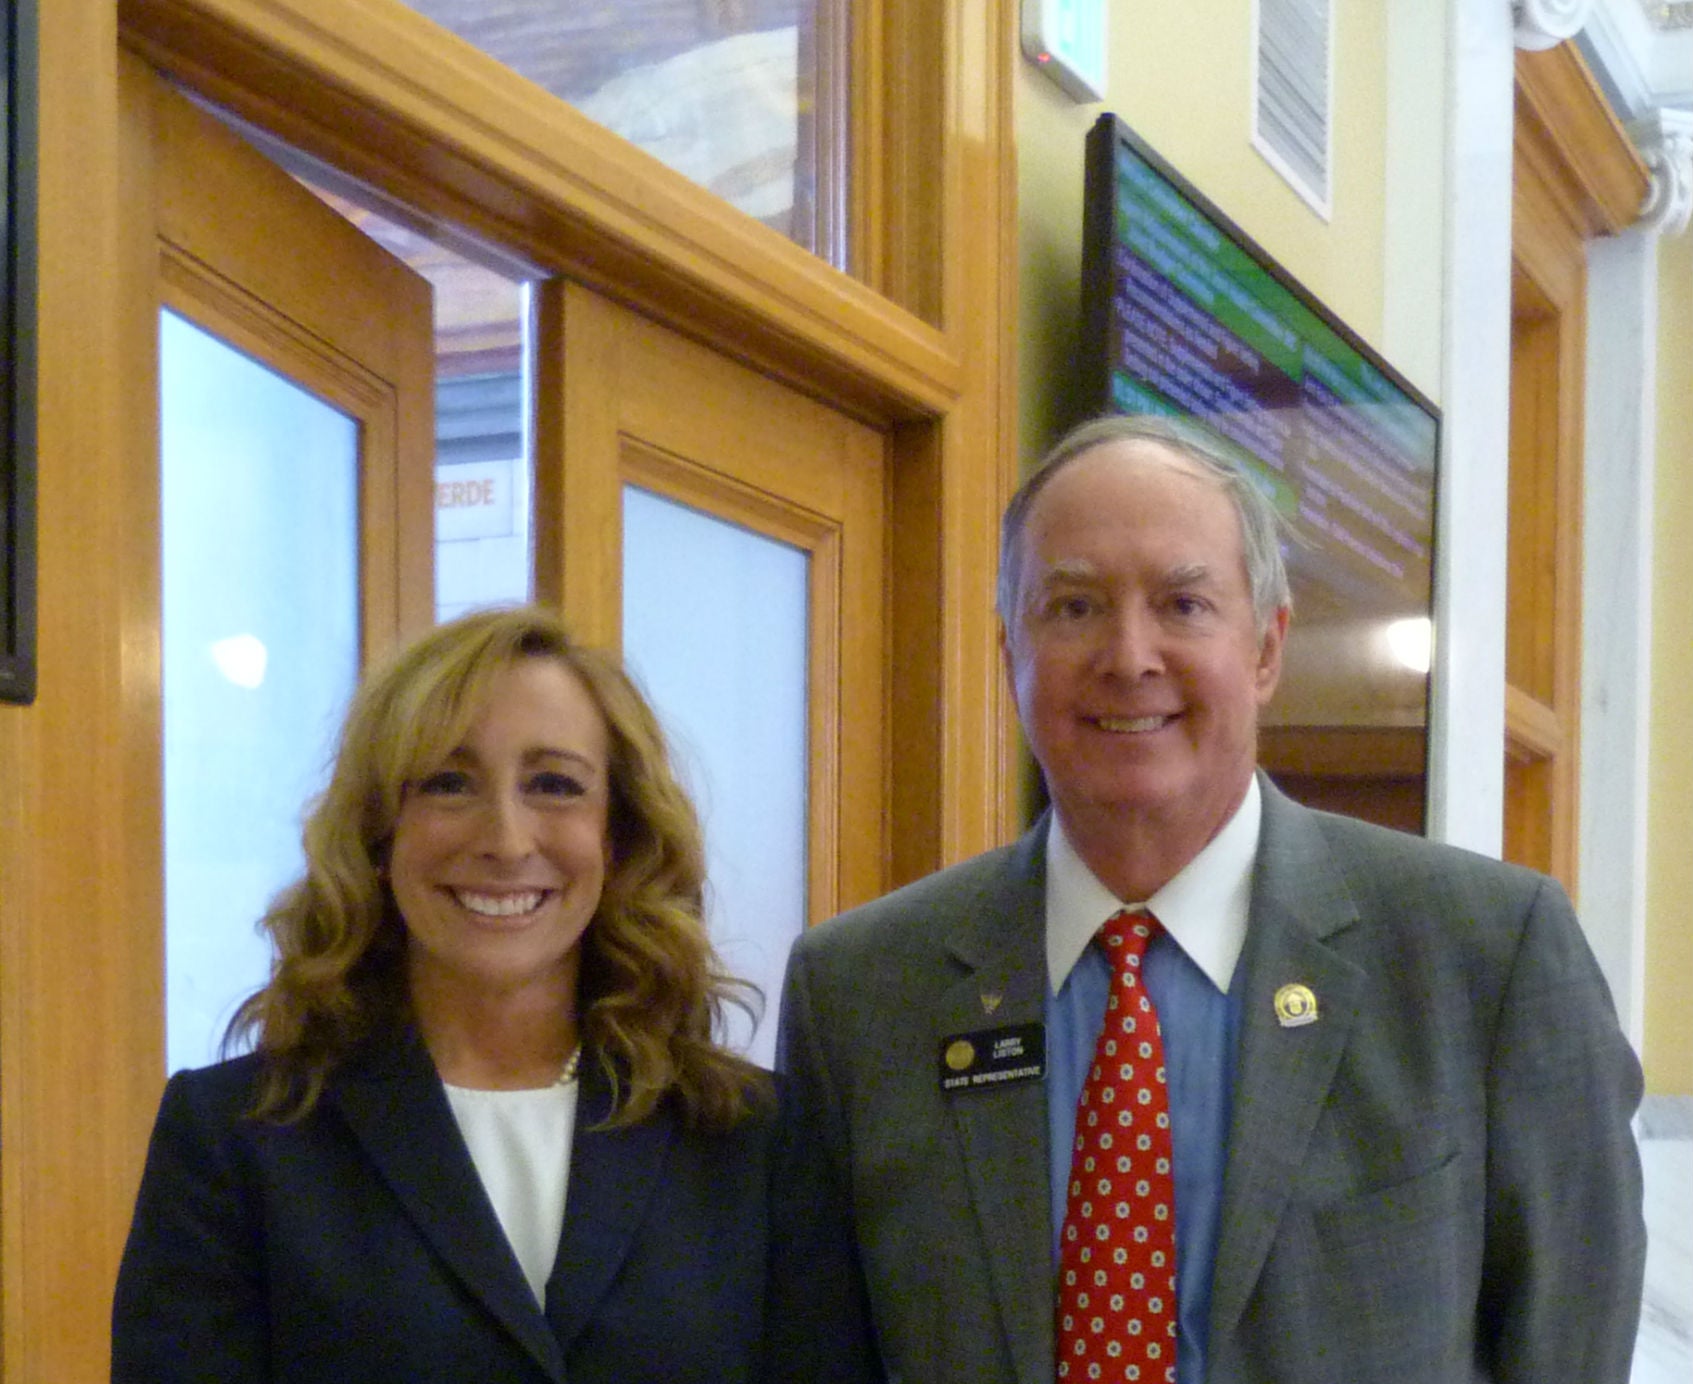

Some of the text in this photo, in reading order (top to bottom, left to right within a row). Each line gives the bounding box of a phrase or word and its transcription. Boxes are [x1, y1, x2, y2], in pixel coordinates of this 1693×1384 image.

[436, 479, 496, 509] ERDE
[945, 1066, 1040, 1089] STATE REPRESENTATIVE
